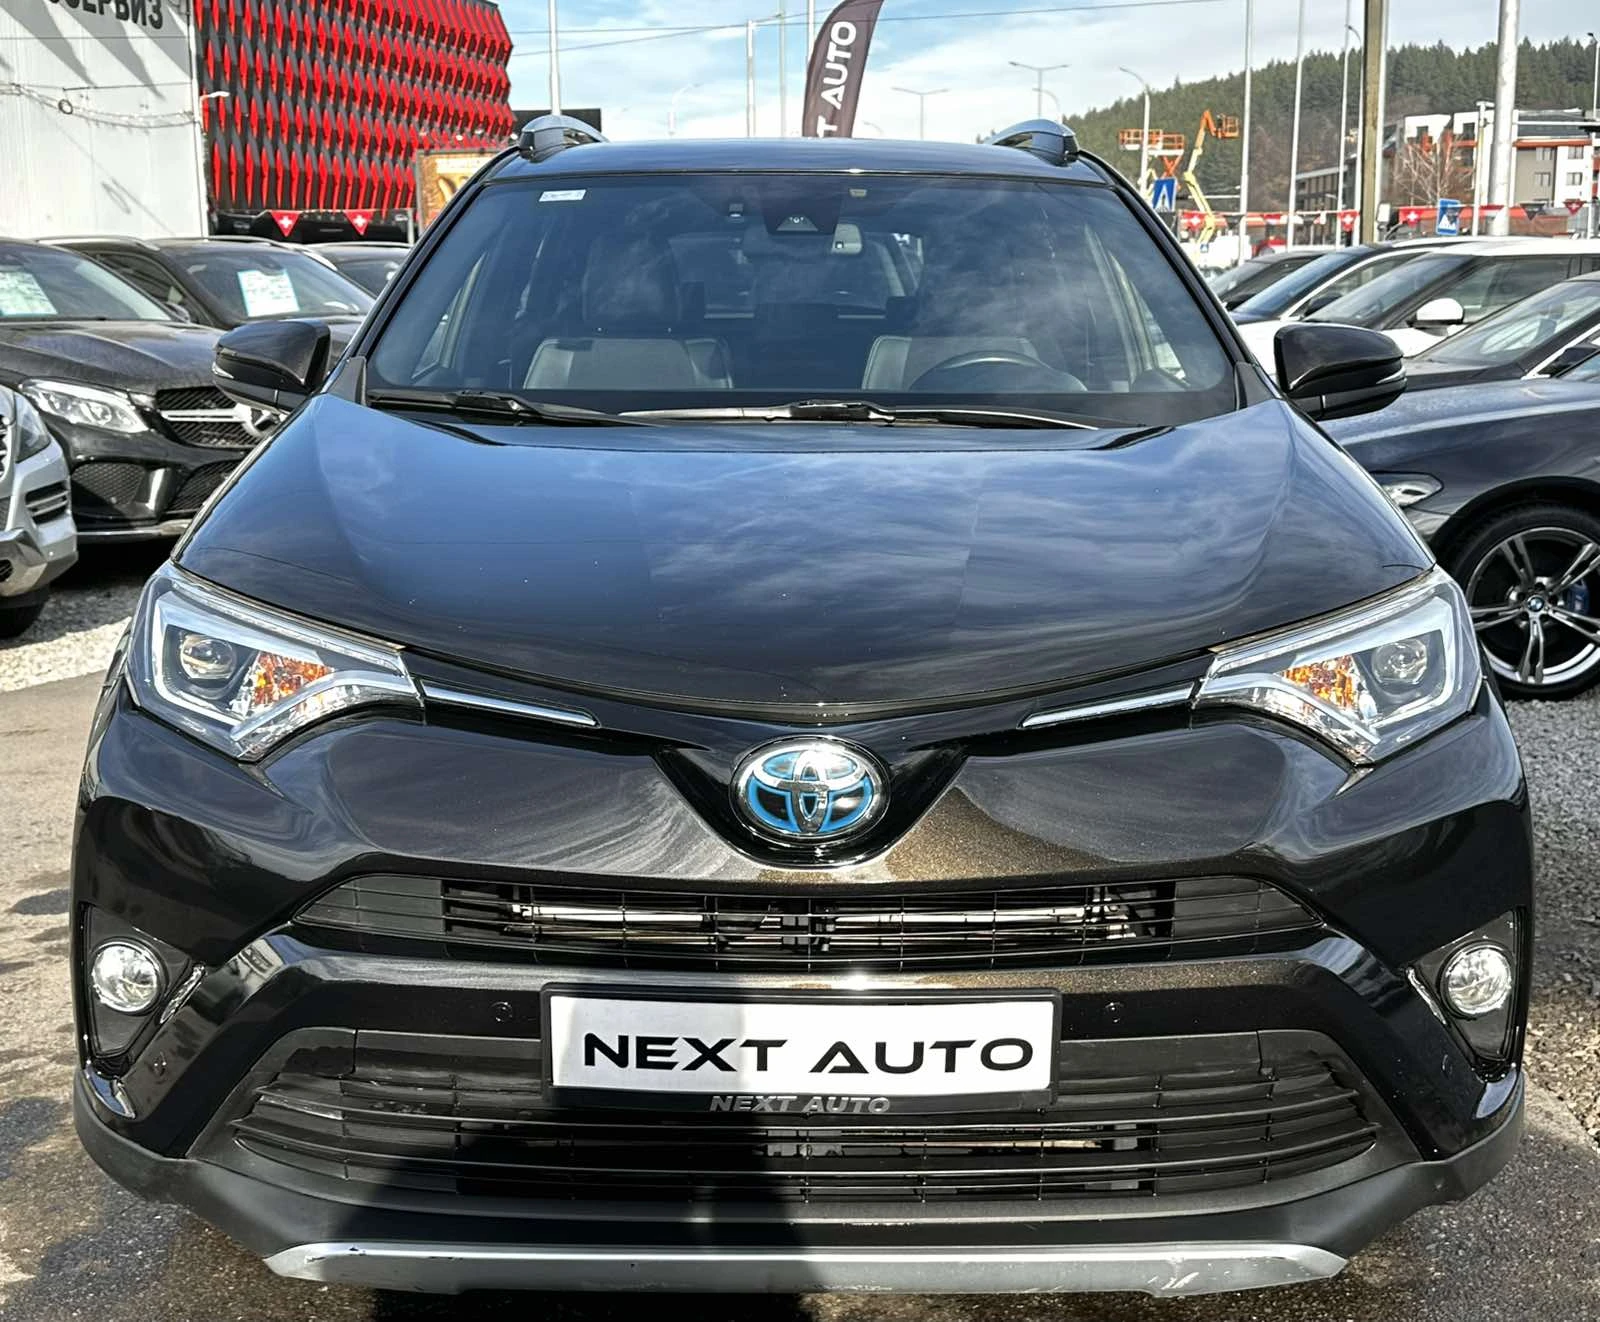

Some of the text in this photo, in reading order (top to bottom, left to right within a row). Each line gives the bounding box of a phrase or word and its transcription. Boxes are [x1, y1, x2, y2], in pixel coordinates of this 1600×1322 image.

[820, 21, 857, 110] AUTO
[584, 1032, 1034, 1074] NEXT AUTO
[709, 1095, 891, 1113] NEXT AUTO
